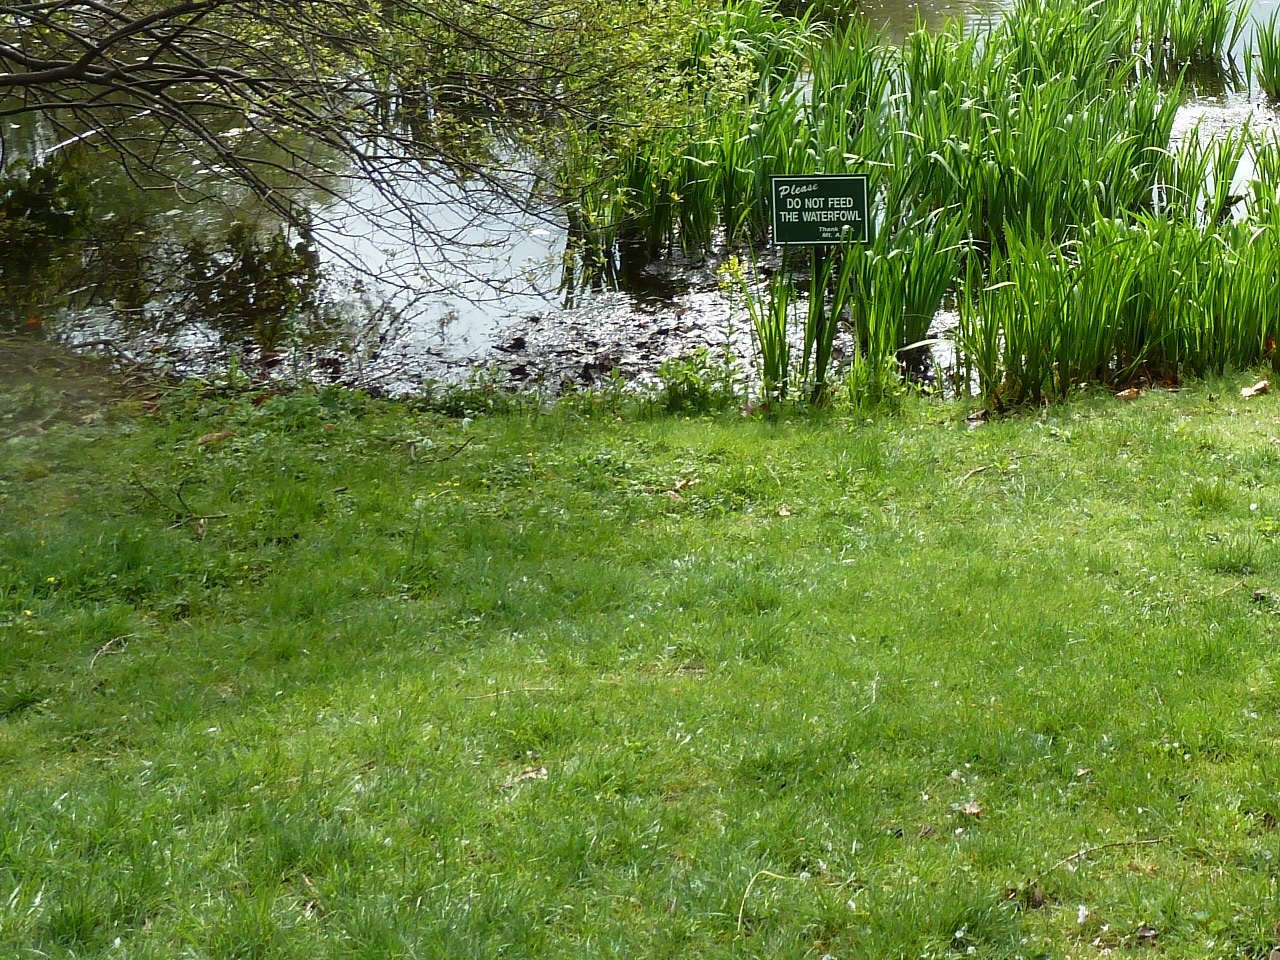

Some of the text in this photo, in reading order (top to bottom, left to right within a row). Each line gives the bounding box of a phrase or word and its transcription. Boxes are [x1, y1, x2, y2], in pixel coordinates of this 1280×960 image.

[778, 183, 819, 198] Please
[787, 197, 854, 208] DO NOT FEED
[780, 210, 862, 222] THE WATERFOWL
